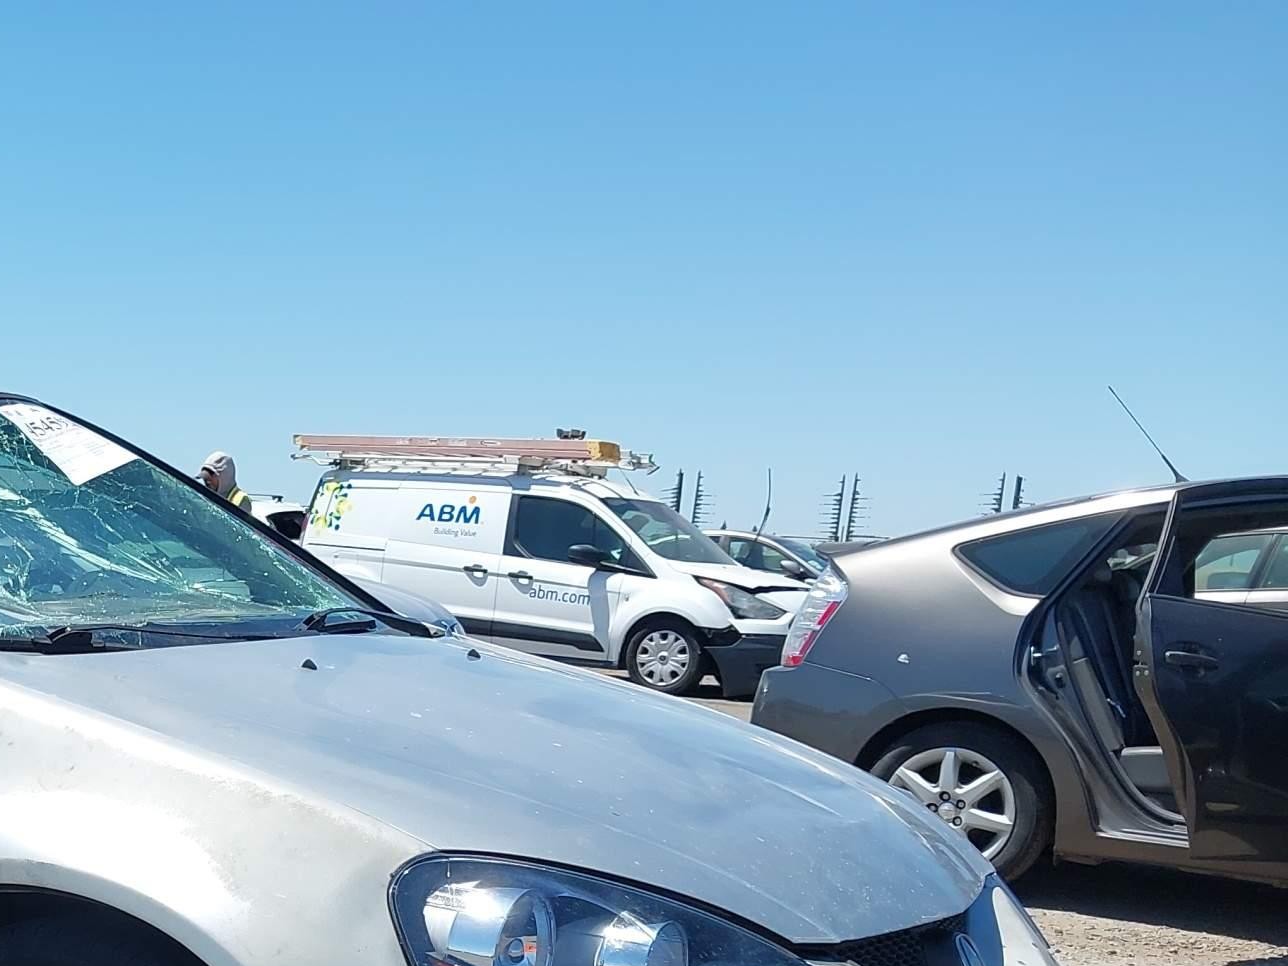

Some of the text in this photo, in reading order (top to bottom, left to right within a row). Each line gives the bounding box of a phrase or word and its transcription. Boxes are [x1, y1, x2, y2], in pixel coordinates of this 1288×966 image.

[415, 503, 481, 525] ABM
[433, 526, 477, 538] Building Value
[529, 584, 591, 606] abm.com
